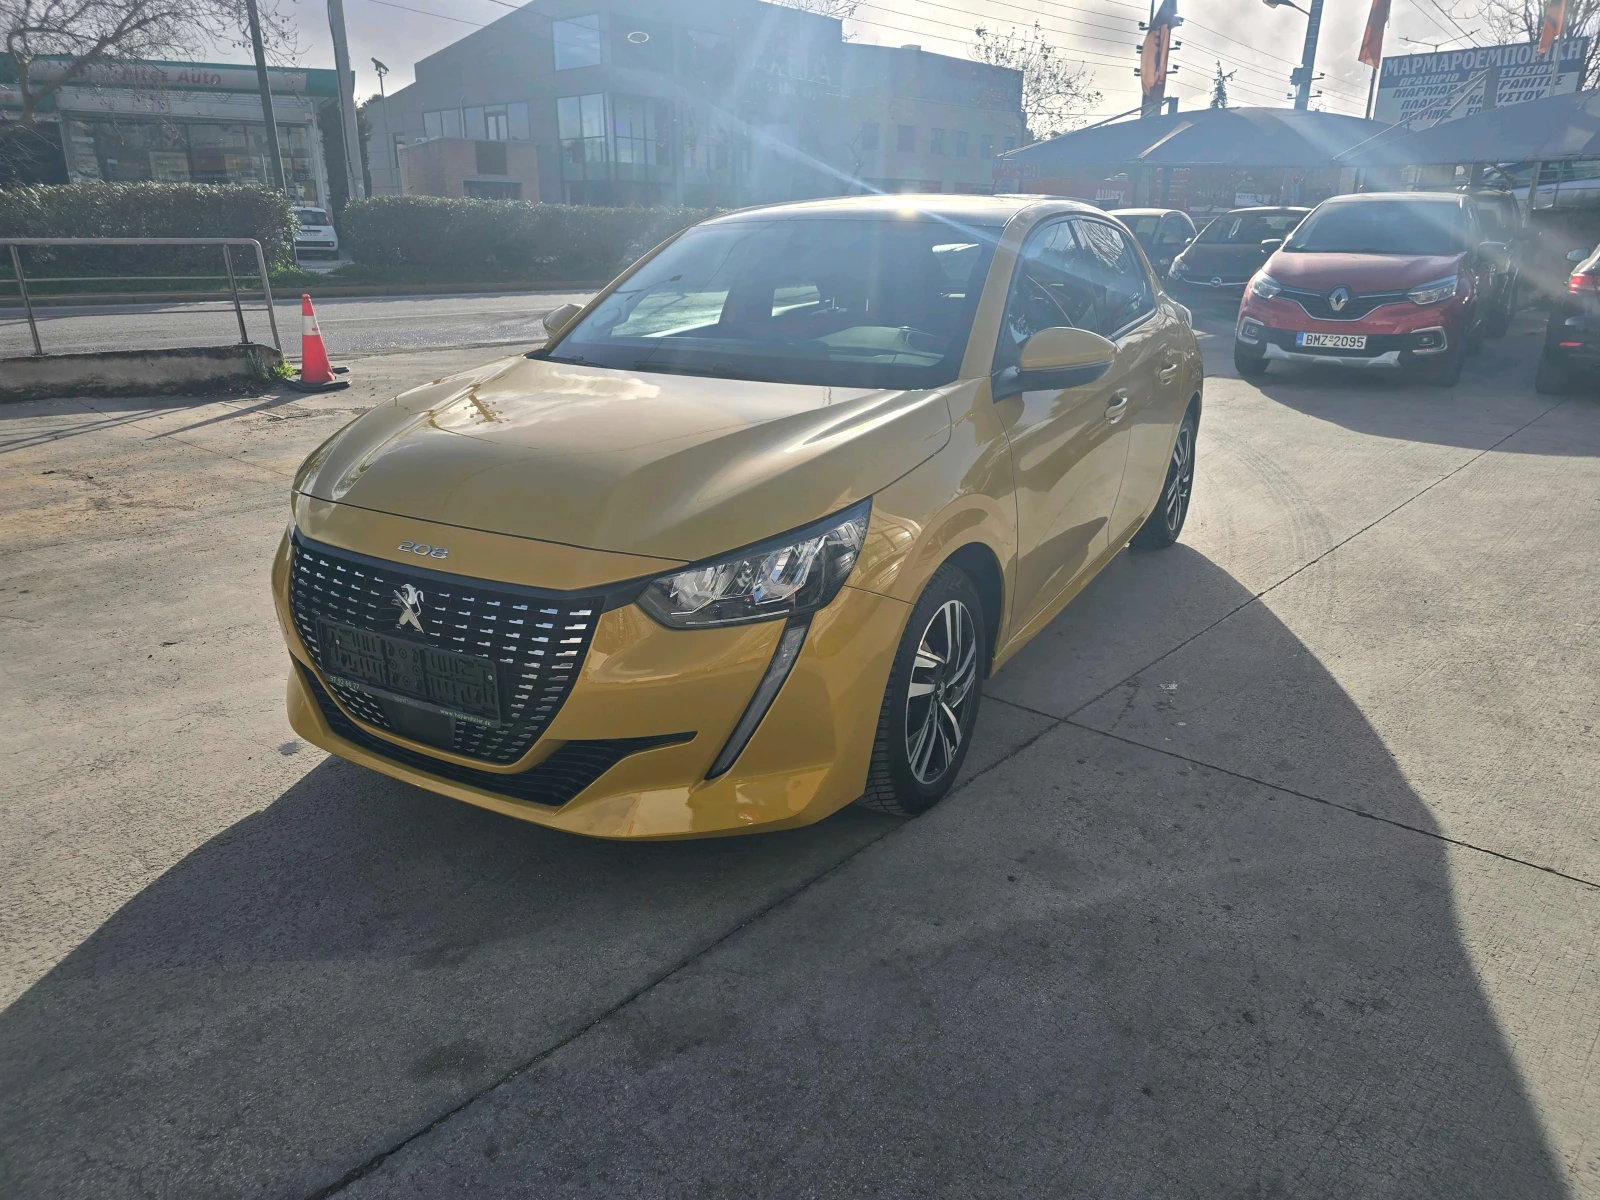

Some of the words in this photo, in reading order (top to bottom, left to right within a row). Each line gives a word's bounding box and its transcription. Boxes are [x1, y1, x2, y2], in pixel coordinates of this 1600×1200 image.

[178, 70, 222, 84] Auto
[1399, 73, 1460, 86] ΠΡΑΤΗΡΙΟ
[1305, 334, 1365, 348] BMZ-2095
[397, 540, 449, 560] 208
